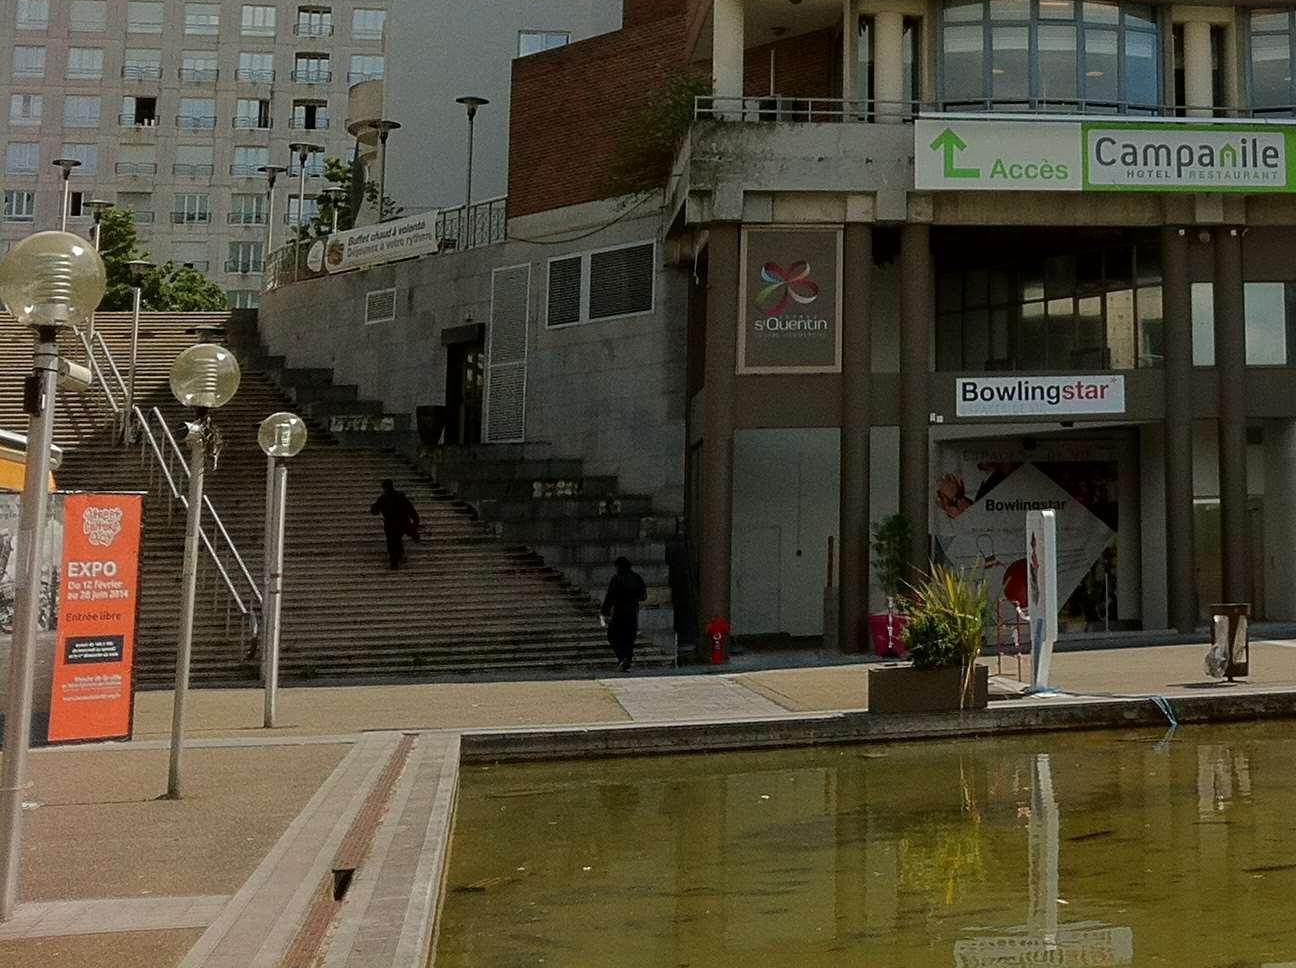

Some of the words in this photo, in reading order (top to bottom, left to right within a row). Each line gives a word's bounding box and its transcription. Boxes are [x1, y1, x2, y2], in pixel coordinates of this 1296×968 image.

[1095, 136, 1280, 178] Campanile
[989, 158, 1069, 180] Accès
[1126, 169, 1171, 179] HOTEL
[1188, 170, 1278, 180] RESTAURANT
[962, 380, 1109, 405] Bowlingstar
[67, 561, 117, 577] EXPO
